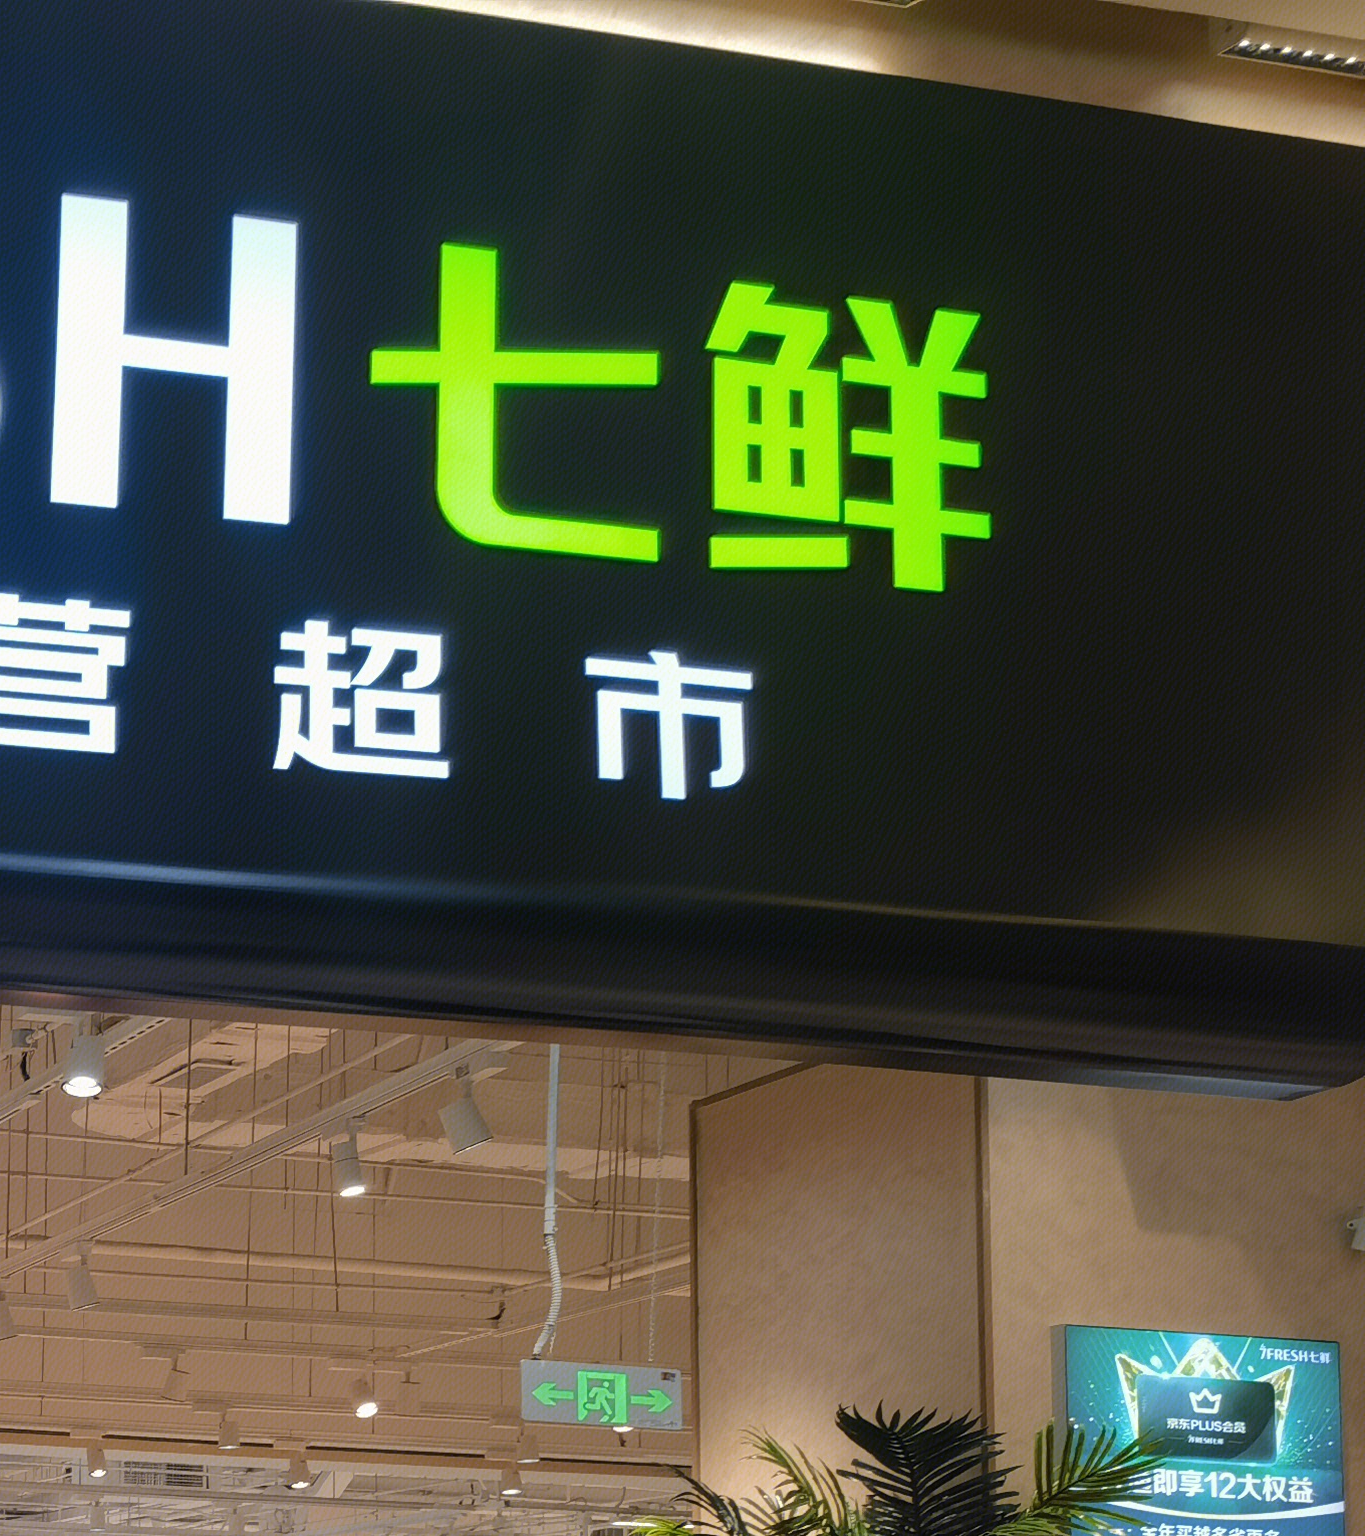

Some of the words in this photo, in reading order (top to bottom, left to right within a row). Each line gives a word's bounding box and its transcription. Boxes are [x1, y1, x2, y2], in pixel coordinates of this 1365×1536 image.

[370, 241, 992, 592] 七鲜
[1166, 1417, 1247, 1434] 京东PLUS会员
